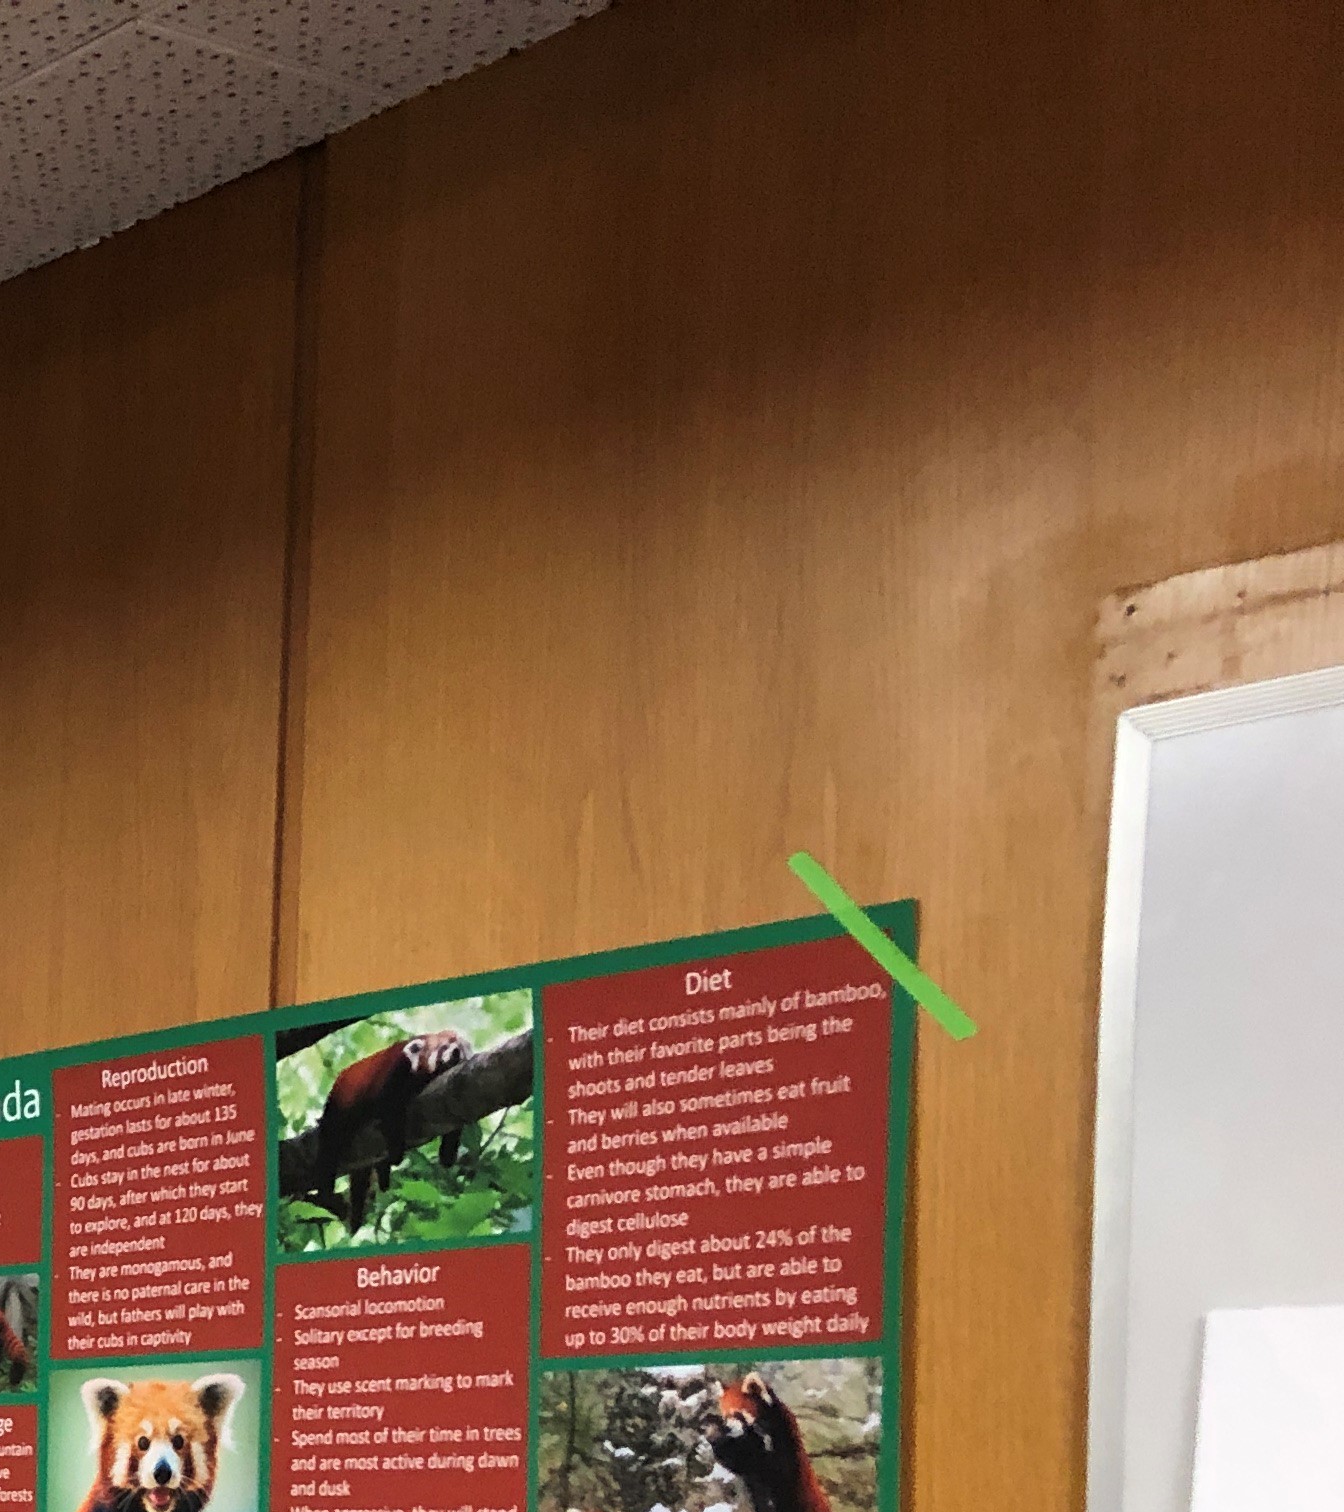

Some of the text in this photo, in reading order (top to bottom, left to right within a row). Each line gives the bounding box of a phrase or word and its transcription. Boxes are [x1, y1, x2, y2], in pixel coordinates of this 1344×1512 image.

[684, 969, 732, 996] Diet
[570, 982, 886, 1043] Their diet consists mainly of bamboo,
[568, 1016, 853, 1070] with their favorite parts being the
[101, 1056, 208, 1089] Reproduction
[567, 1058, 774, 1099] shoots and tender leaves
[70, 1083, 236, 1118] Mating occurs in late winter,
[70, 1103, 237, 1144] gestation lasts for about 135
[356, 1263, 440, 1288] Behavior
[294, 1296, 445, 1320] Scansorial locomotion
[294, 1319, 483, 1346] Solitary except for breeding
[293, 1355, 340, 1371] season
